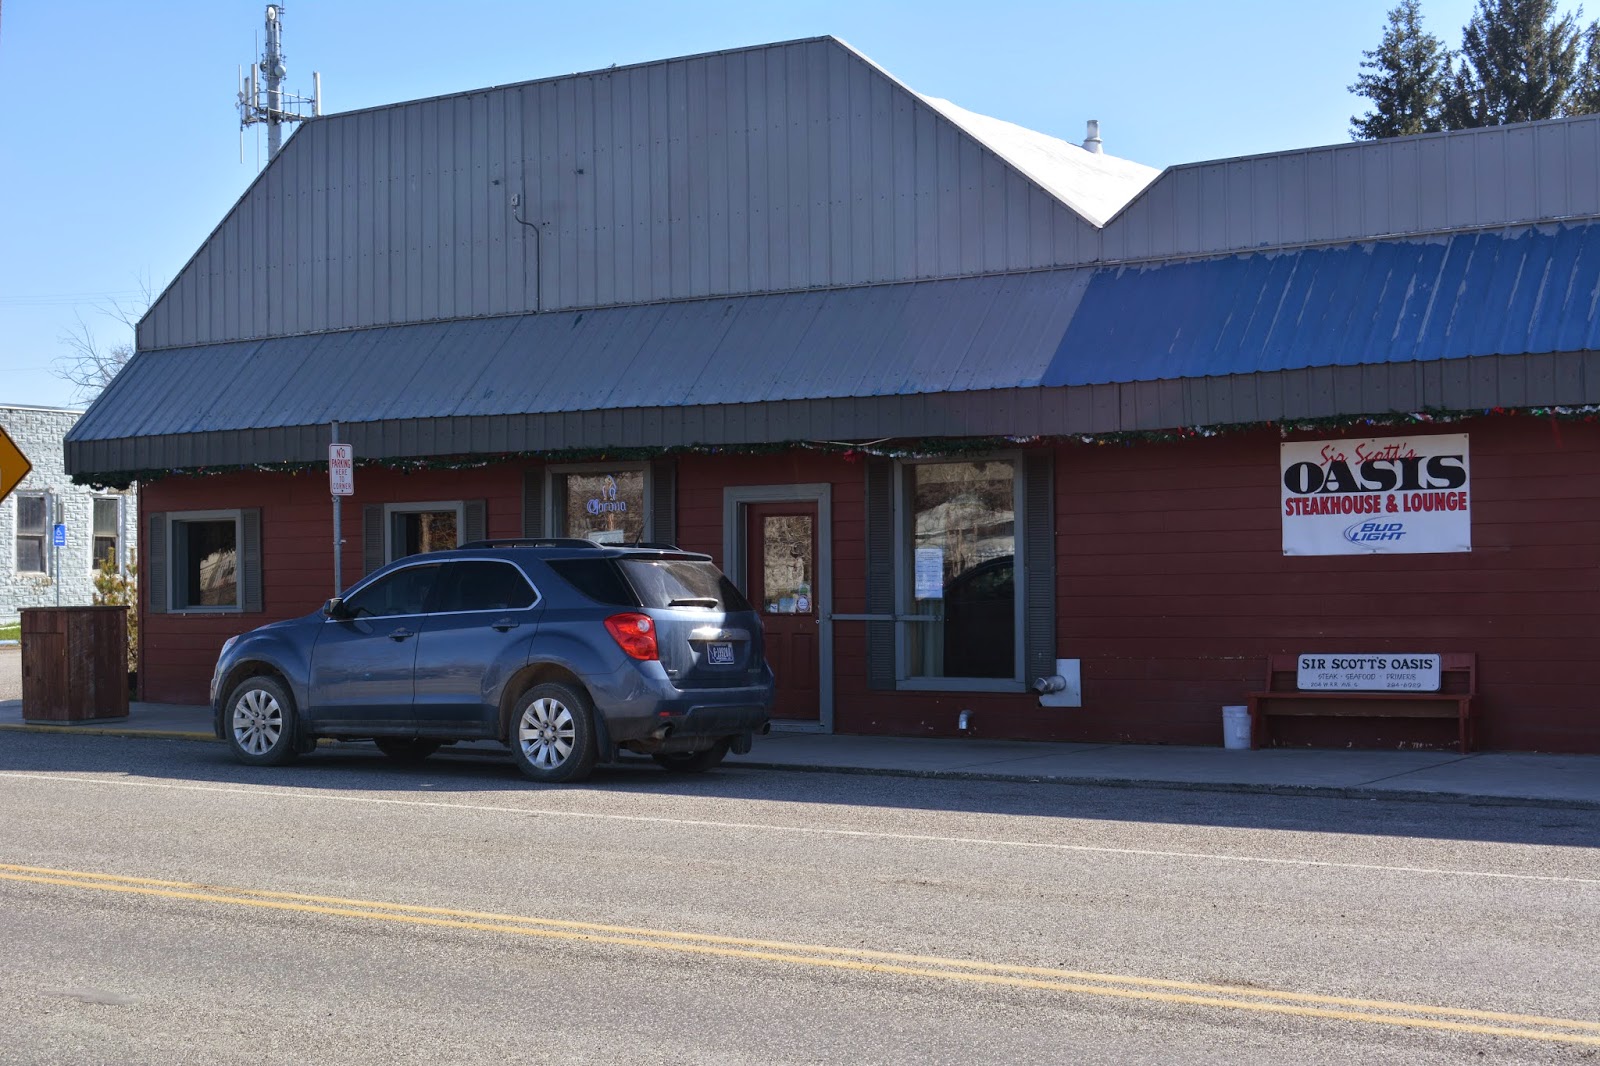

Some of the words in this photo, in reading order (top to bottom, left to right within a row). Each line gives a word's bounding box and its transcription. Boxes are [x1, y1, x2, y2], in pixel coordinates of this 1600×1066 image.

[336, 449, 346, 458] NO
[1320, 444, 1348, 466] Sir
[1354, 442, 1417, 466] Scott's
[331, 458, 351, 468] PARKING
[1284, 455, 1467, 494] OASIS
[333, 482, 352, 490] CORNER
[586, 498, 627, 515] Corona
[1285, 494, 1381, 516] STEAKHOUSE
[1385, 493, 1399, 513] &
[1403, 491, 1467, 512] LOUNGE
[1360, 522, 1403, 532] BUD
[1350, 531, 1407, 542] LIGHT
[1302, 658, 1326, 670] SIR
[1331, 656, 1387, 670] SCOTT'S
[1391, 658, 1433, 669] OASIS
